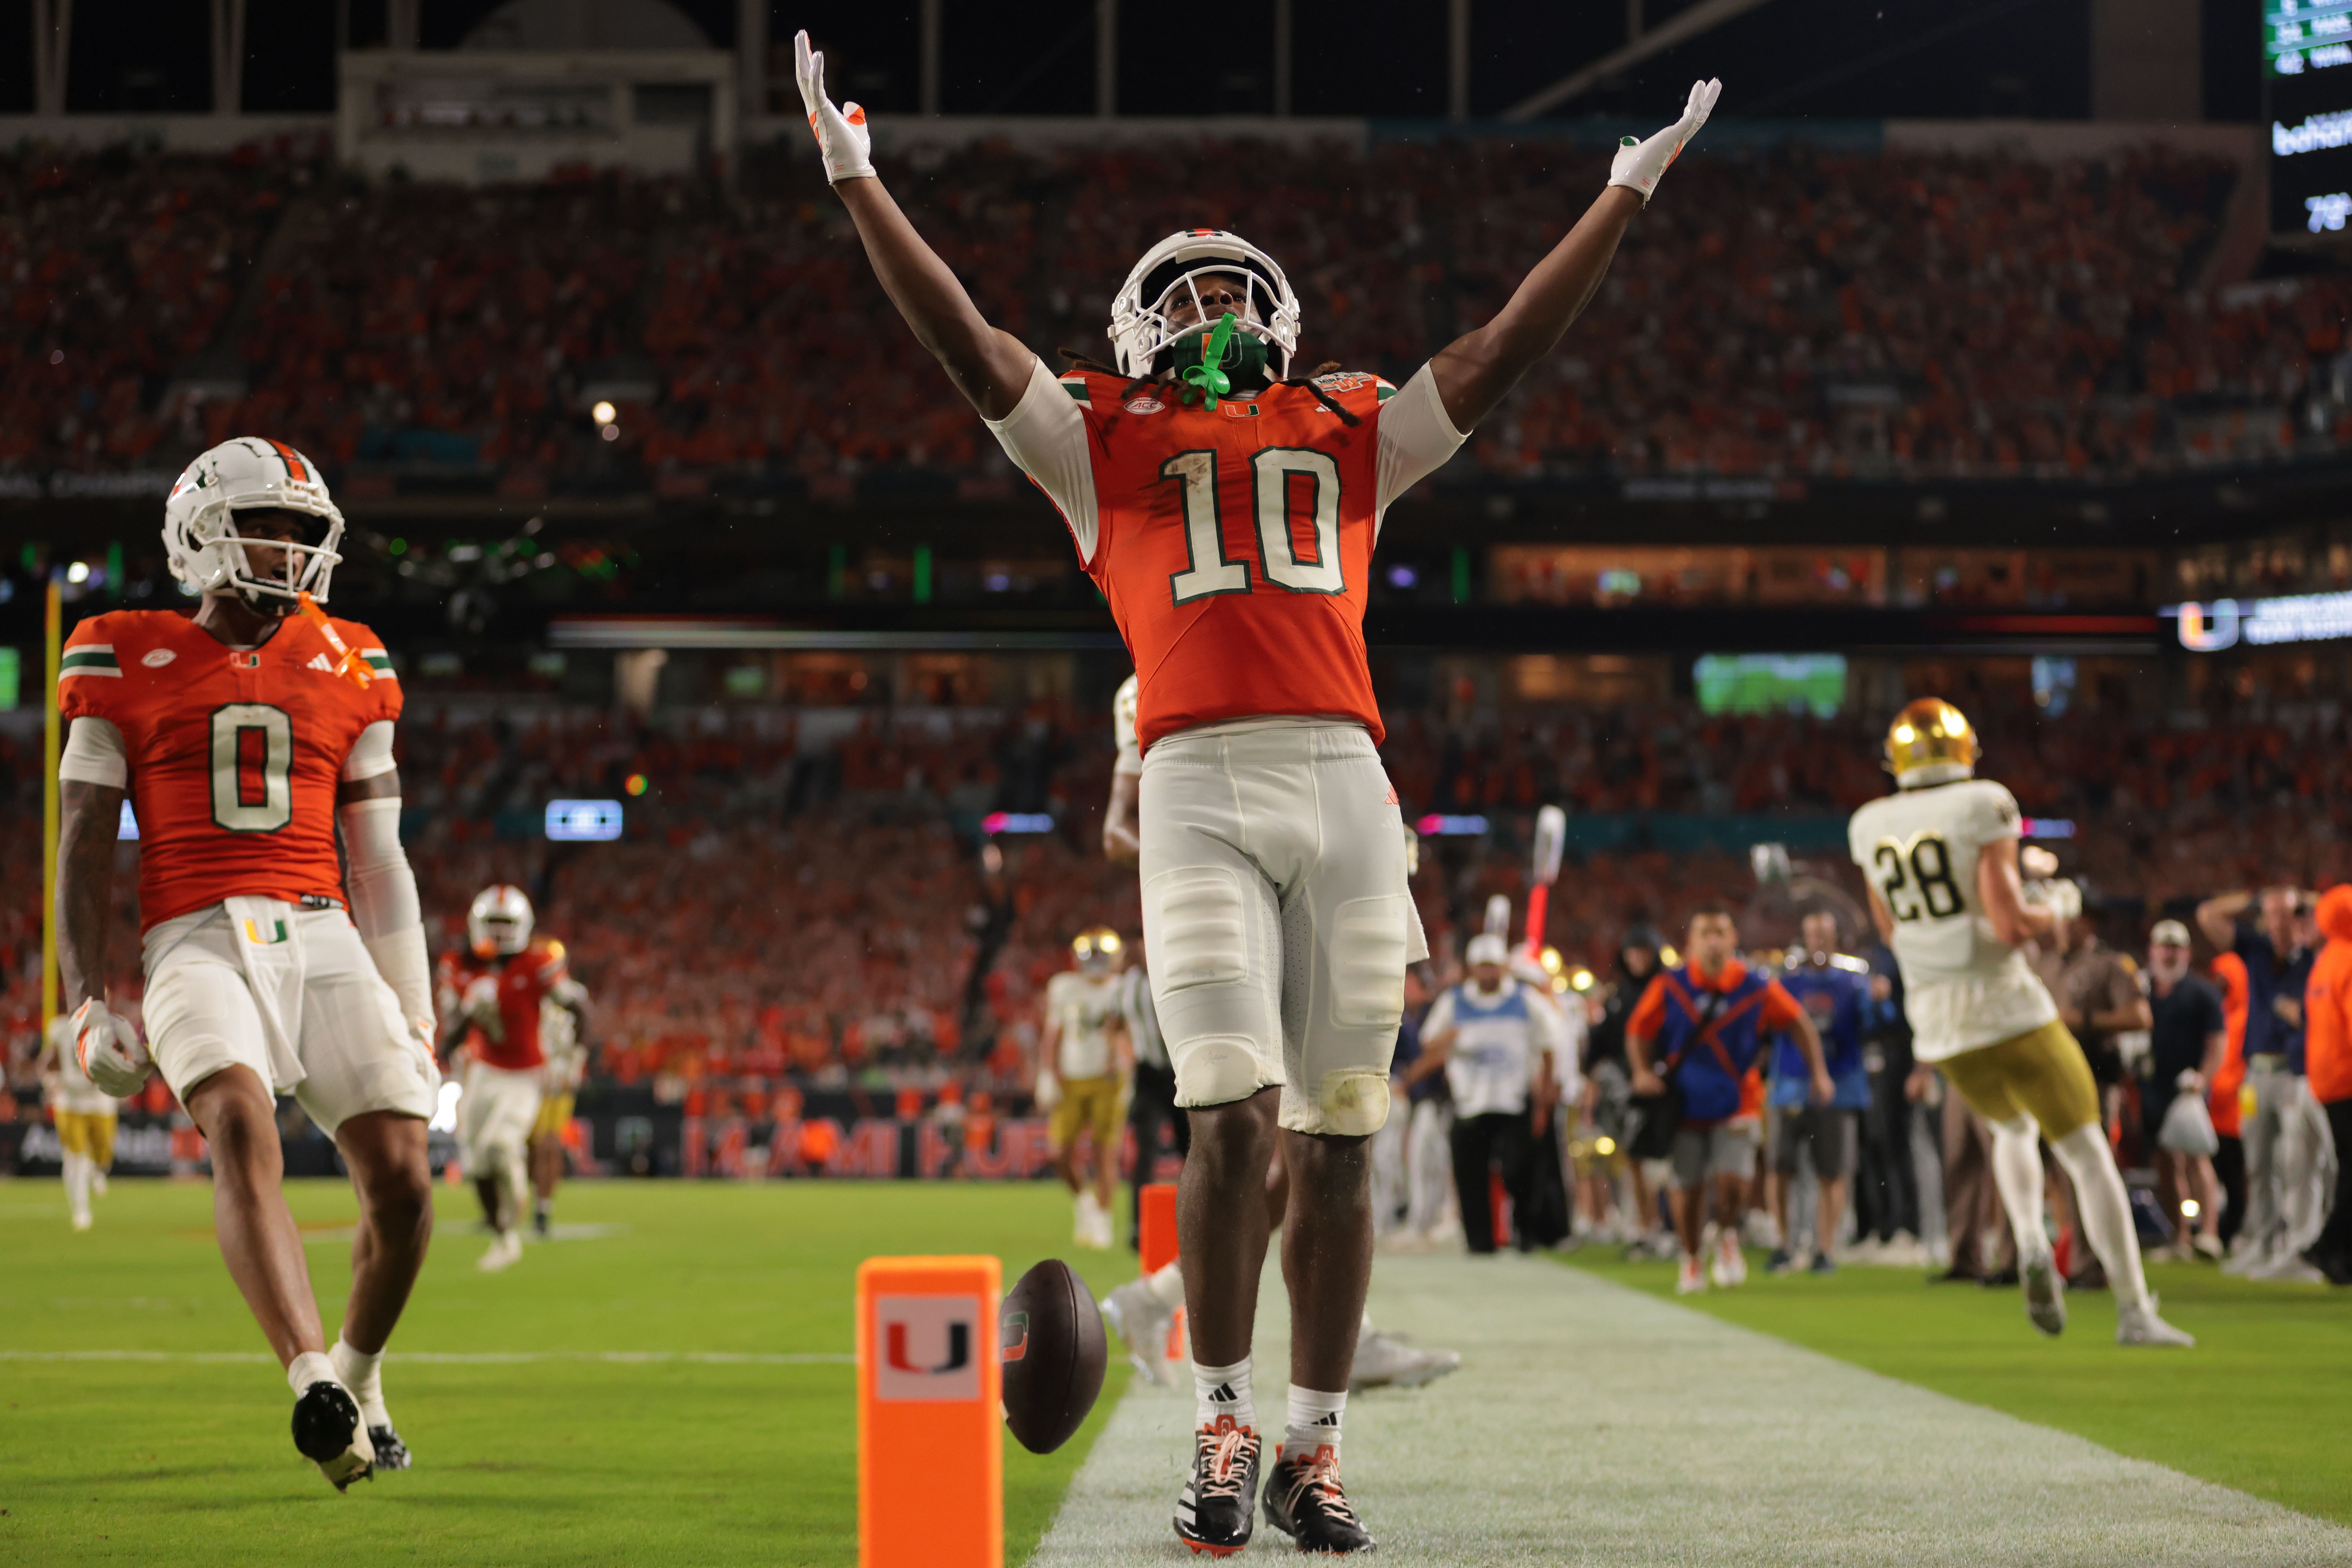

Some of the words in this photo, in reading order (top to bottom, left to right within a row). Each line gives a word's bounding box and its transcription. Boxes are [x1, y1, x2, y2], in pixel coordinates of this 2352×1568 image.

[1334, 377, 1359, 390] 10
[1225, 404, 1260, 418] U
[1159, 445, 1348, 608] 10
[229, 652, 261, 669] U
[209, 702, 294, 834] 0
[1875, 837, 1967, 922] 28
[243, 919, 288, 945] U
[886, 1321, 970, 1375] U
